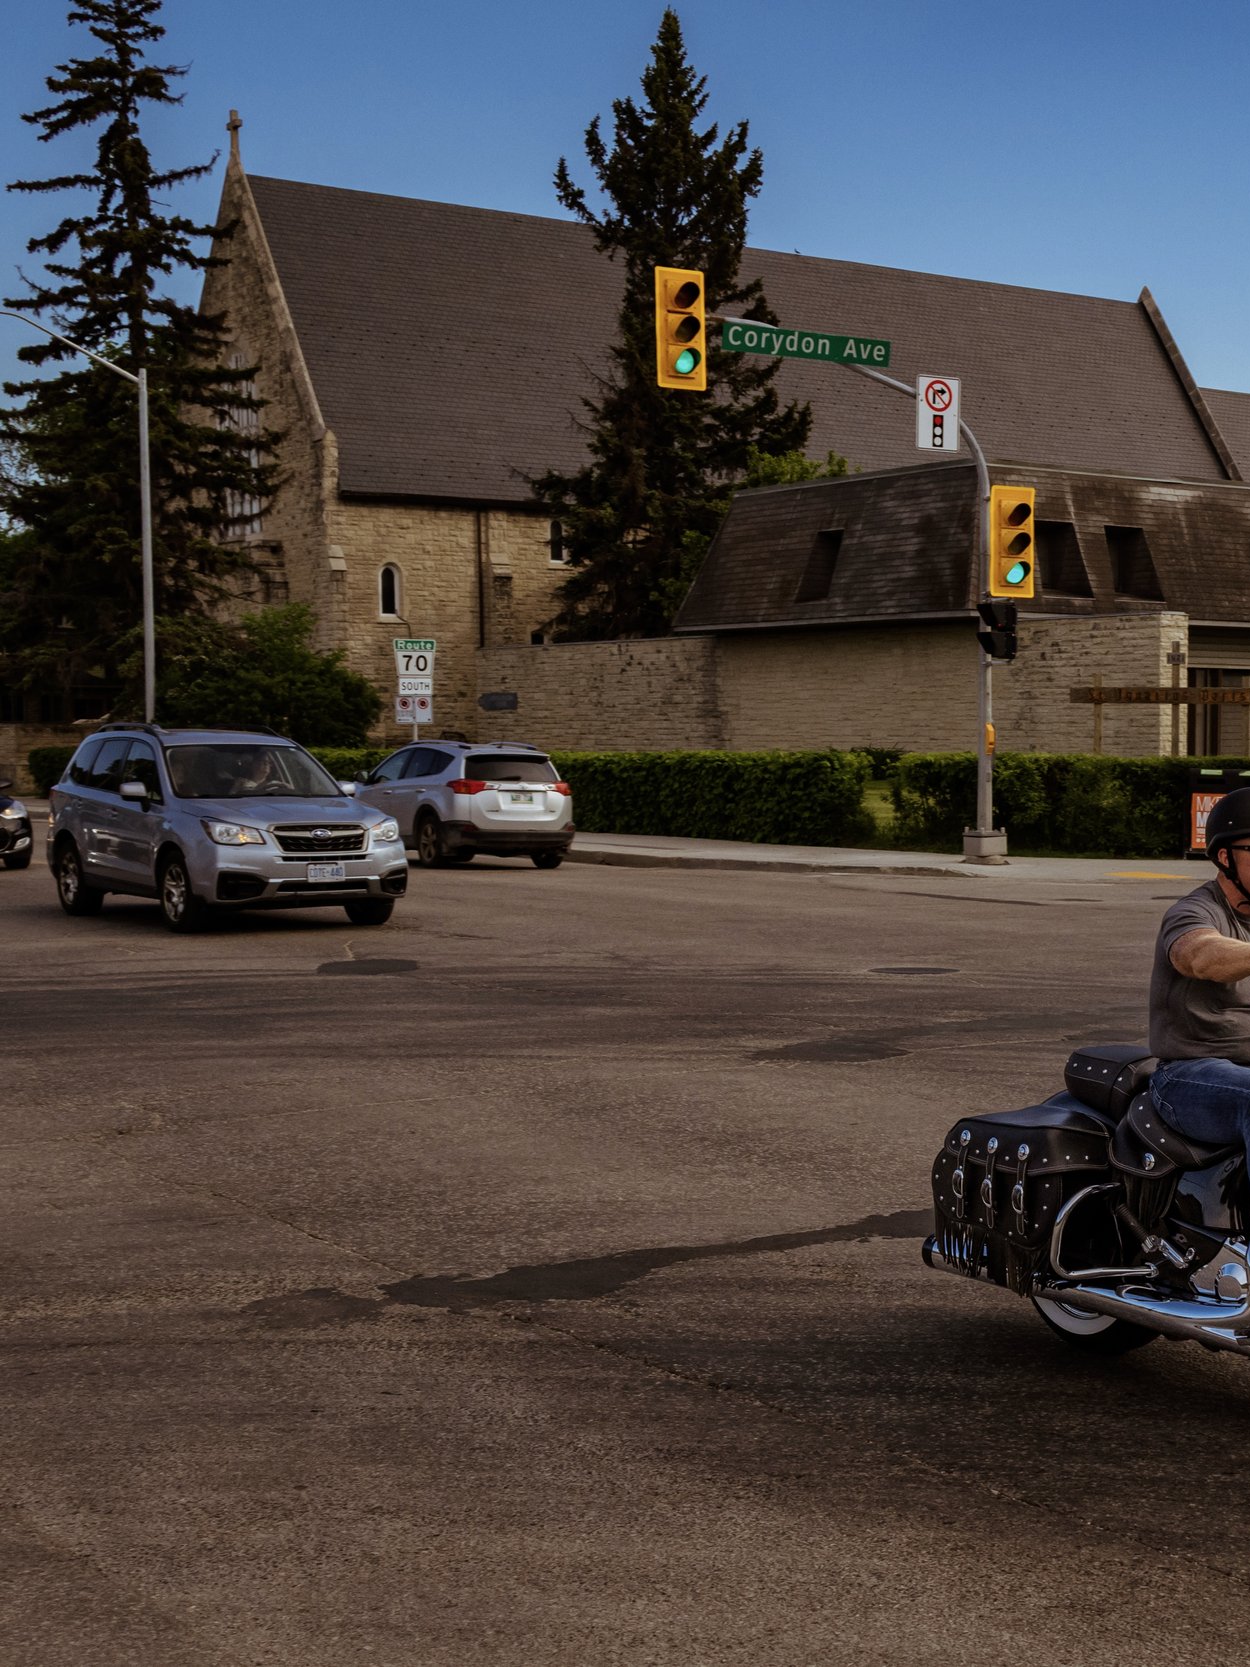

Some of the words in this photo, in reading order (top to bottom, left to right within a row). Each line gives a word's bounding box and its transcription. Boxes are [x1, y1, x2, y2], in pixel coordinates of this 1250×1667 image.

[728, 325, 830, 355] Corydon
[843, 338, 886, 361] Ave
[397, 641, 433, 650] Route
[402, 655, 428, 671] 70
[401, 682, 430, 691] SOUTH
